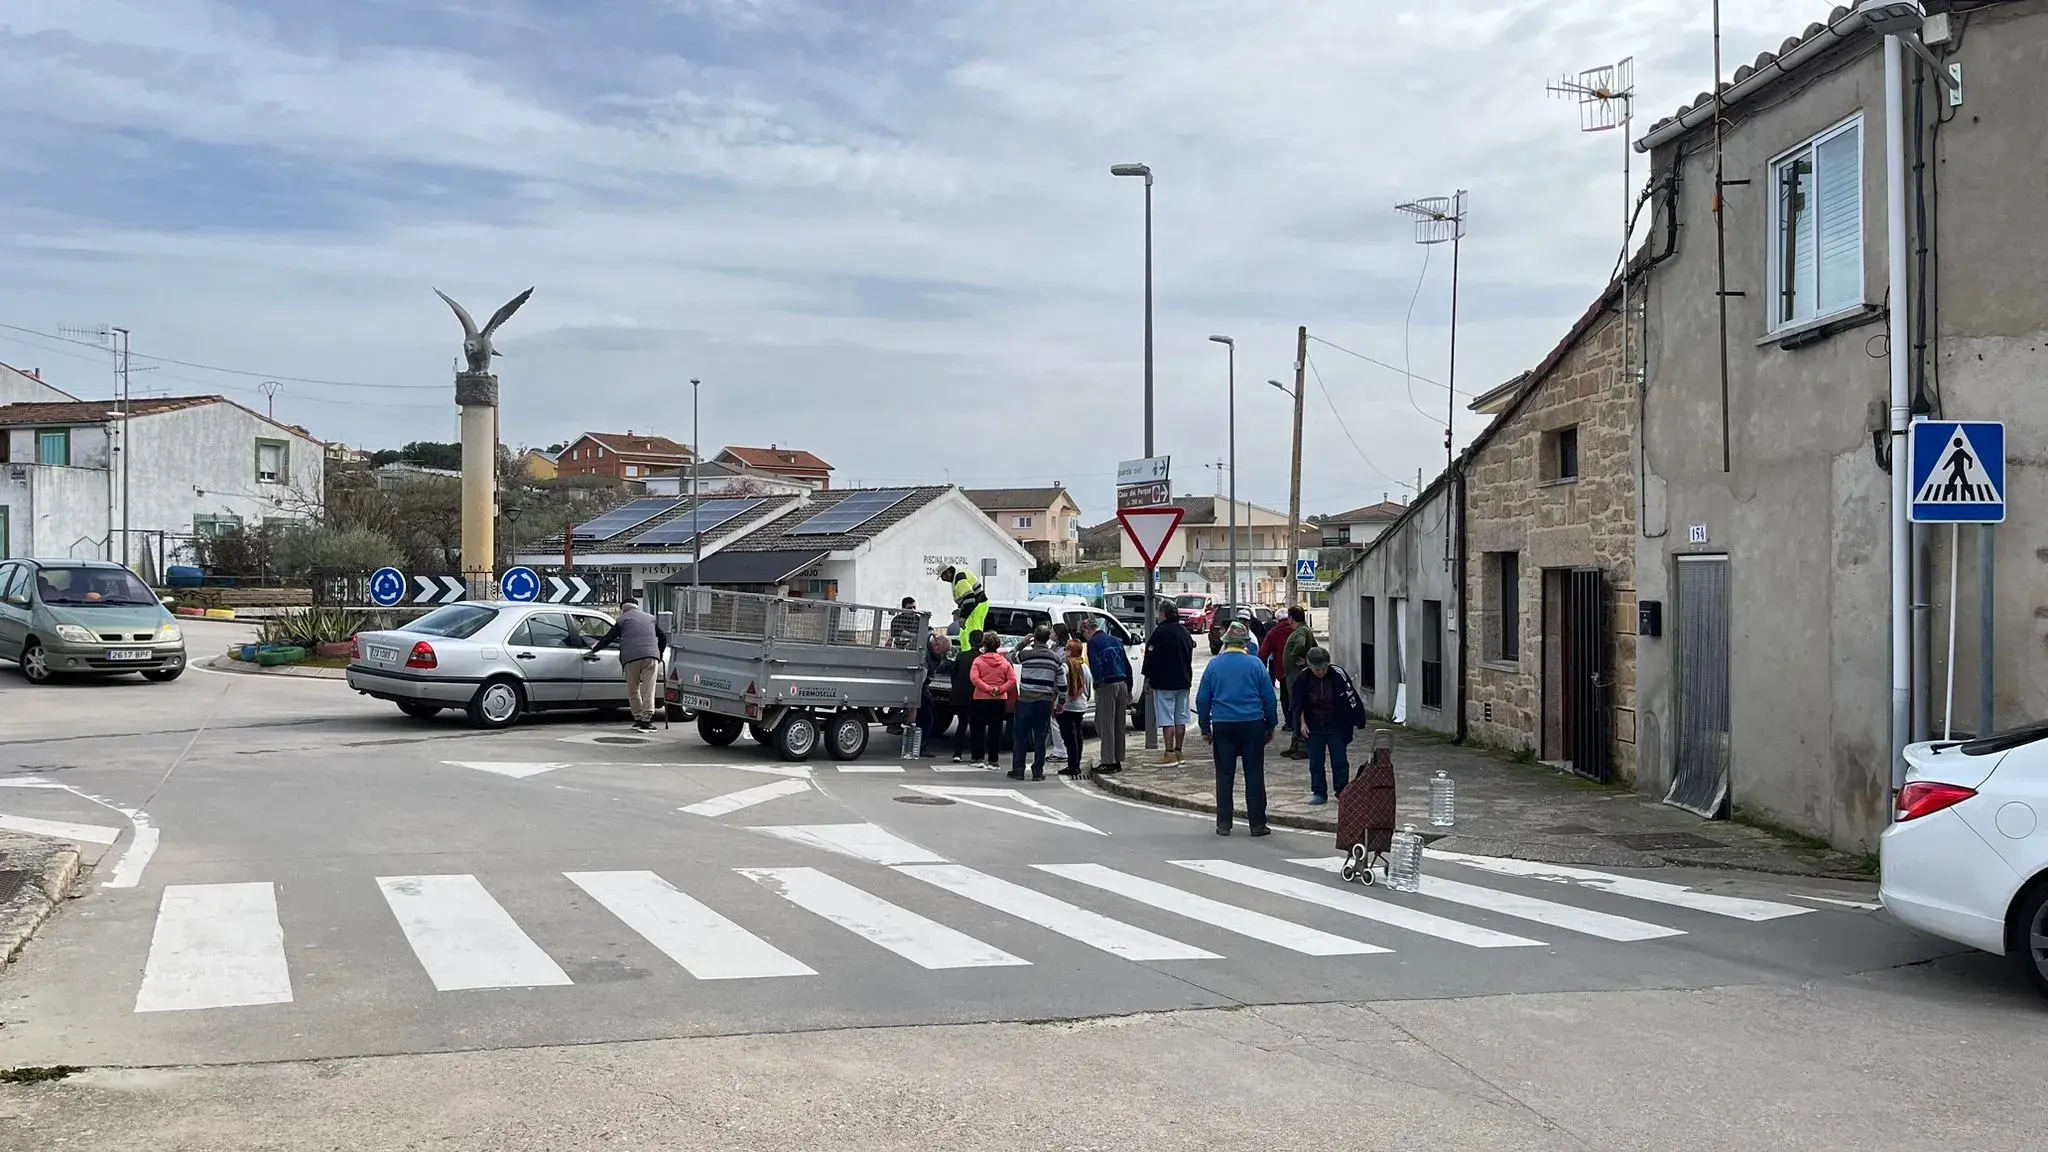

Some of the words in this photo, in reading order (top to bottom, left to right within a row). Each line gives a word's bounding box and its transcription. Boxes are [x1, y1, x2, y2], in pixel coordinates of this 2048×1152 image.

[1118, 490, 1128, 498] Casa
[1137, 487, 1151, 496] Parque
[1692, 526, 1705, 541] 154
[923, 555, 942, 564] PISCINA
[700, 679, 731, 691] FERMOSELLE
[799, 690, 836, 698] FERMOSELLE
